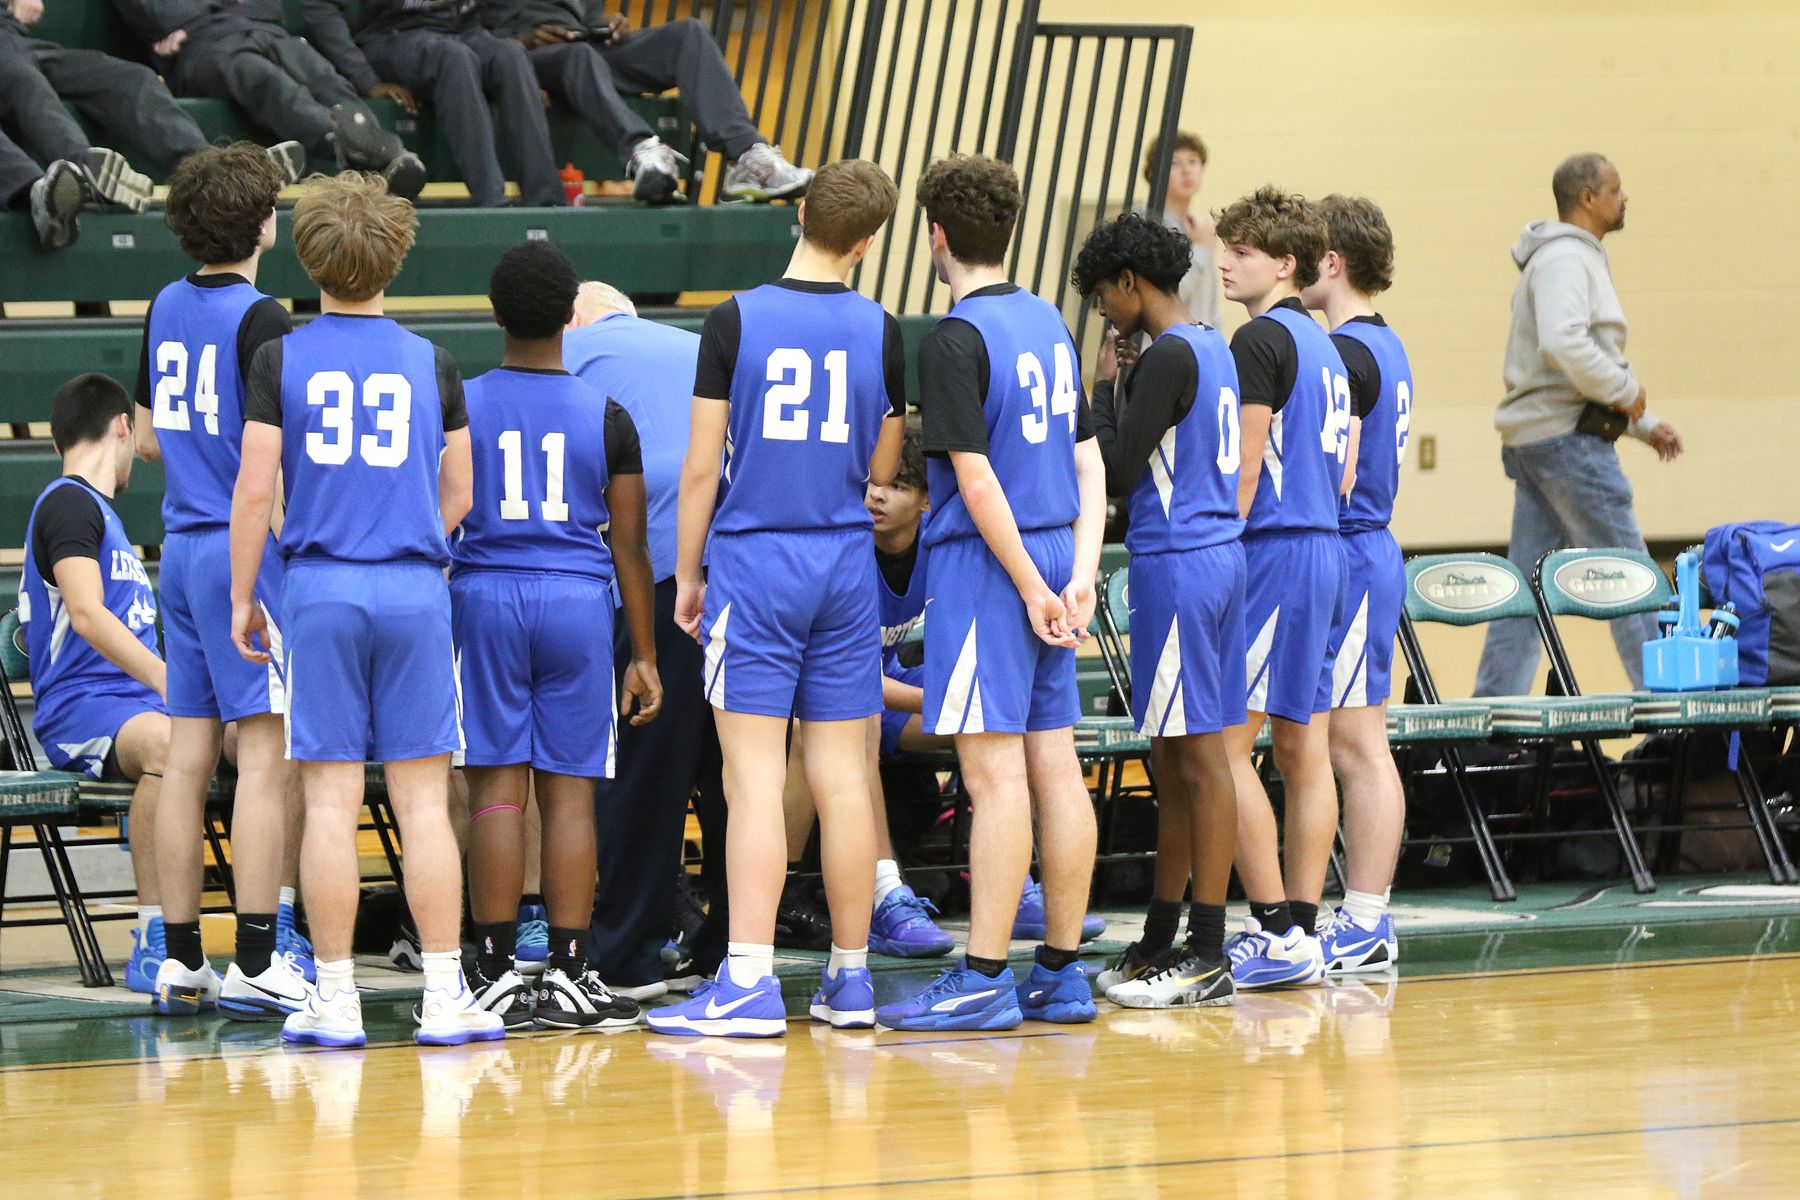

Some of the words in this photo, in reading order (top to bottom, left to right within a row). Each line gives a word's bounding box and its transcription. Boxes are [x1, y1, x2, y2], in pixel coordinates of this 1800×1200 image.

[153, 341, 219, 435] 24
[305, 371, 412, 467] 33
[762, 348, 850, 443] 21
[1016, 342, 1077, 444] 34
[1216, 387, 1240, 474] 0
[498, 430, 569, 521] 11
[1405, 716, 1445, 734] RIVER
[1548, 709, 1588, 728] RIVER
[1591, 706, 1628, 724] BLUFF
[1688, 700, 1725, 718] RIVER
[1728, 699, 1765, 716] BLUFF
